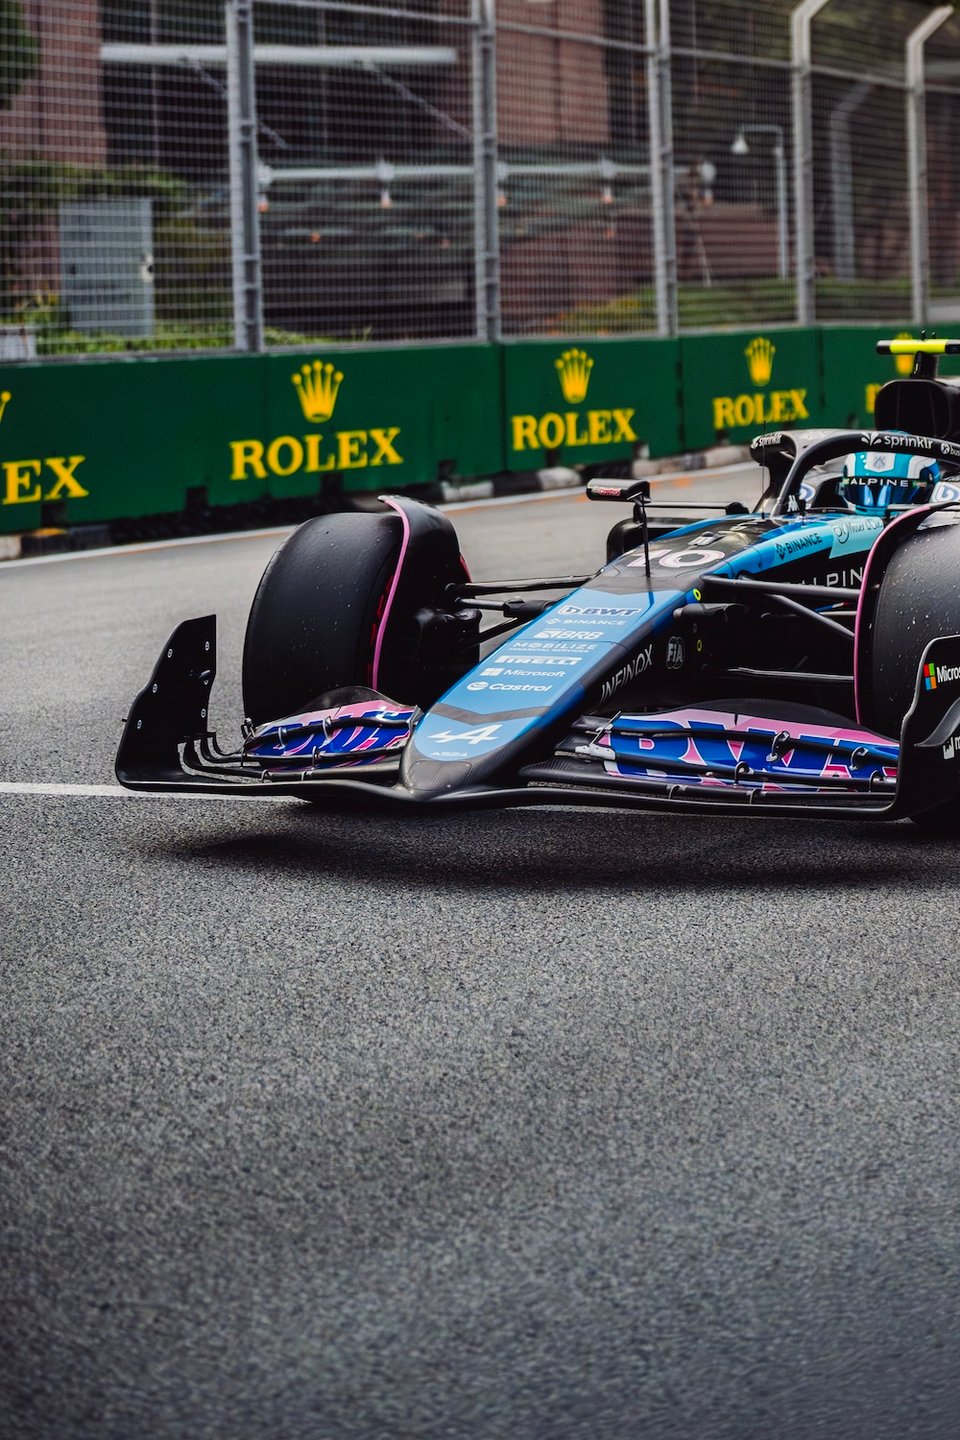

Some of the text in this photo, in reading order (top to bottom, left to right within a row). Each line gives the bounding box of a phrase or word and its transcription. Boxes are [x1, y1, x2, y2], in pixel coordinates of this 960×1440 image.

[712, 389, 808, 429] ROLEX
[512, 408, 637, 452] ROLEX
[884, 434, 933, 450] sprinklr
[230, 426, 403, 481] ROLEX
[850, 477, 908, 488] ALPINE
[786, 532, 823, 554] BINANCE
[627, 549, 726, 568] 10
[581, 606, 641, 617] BWT
[512, 642, 598, 651] MOBILIZE
[504, 669, 566, 677] Microsoft
[600, 644, 653, 702] INFINOX
[489, 683, 553, 692] Castrol
